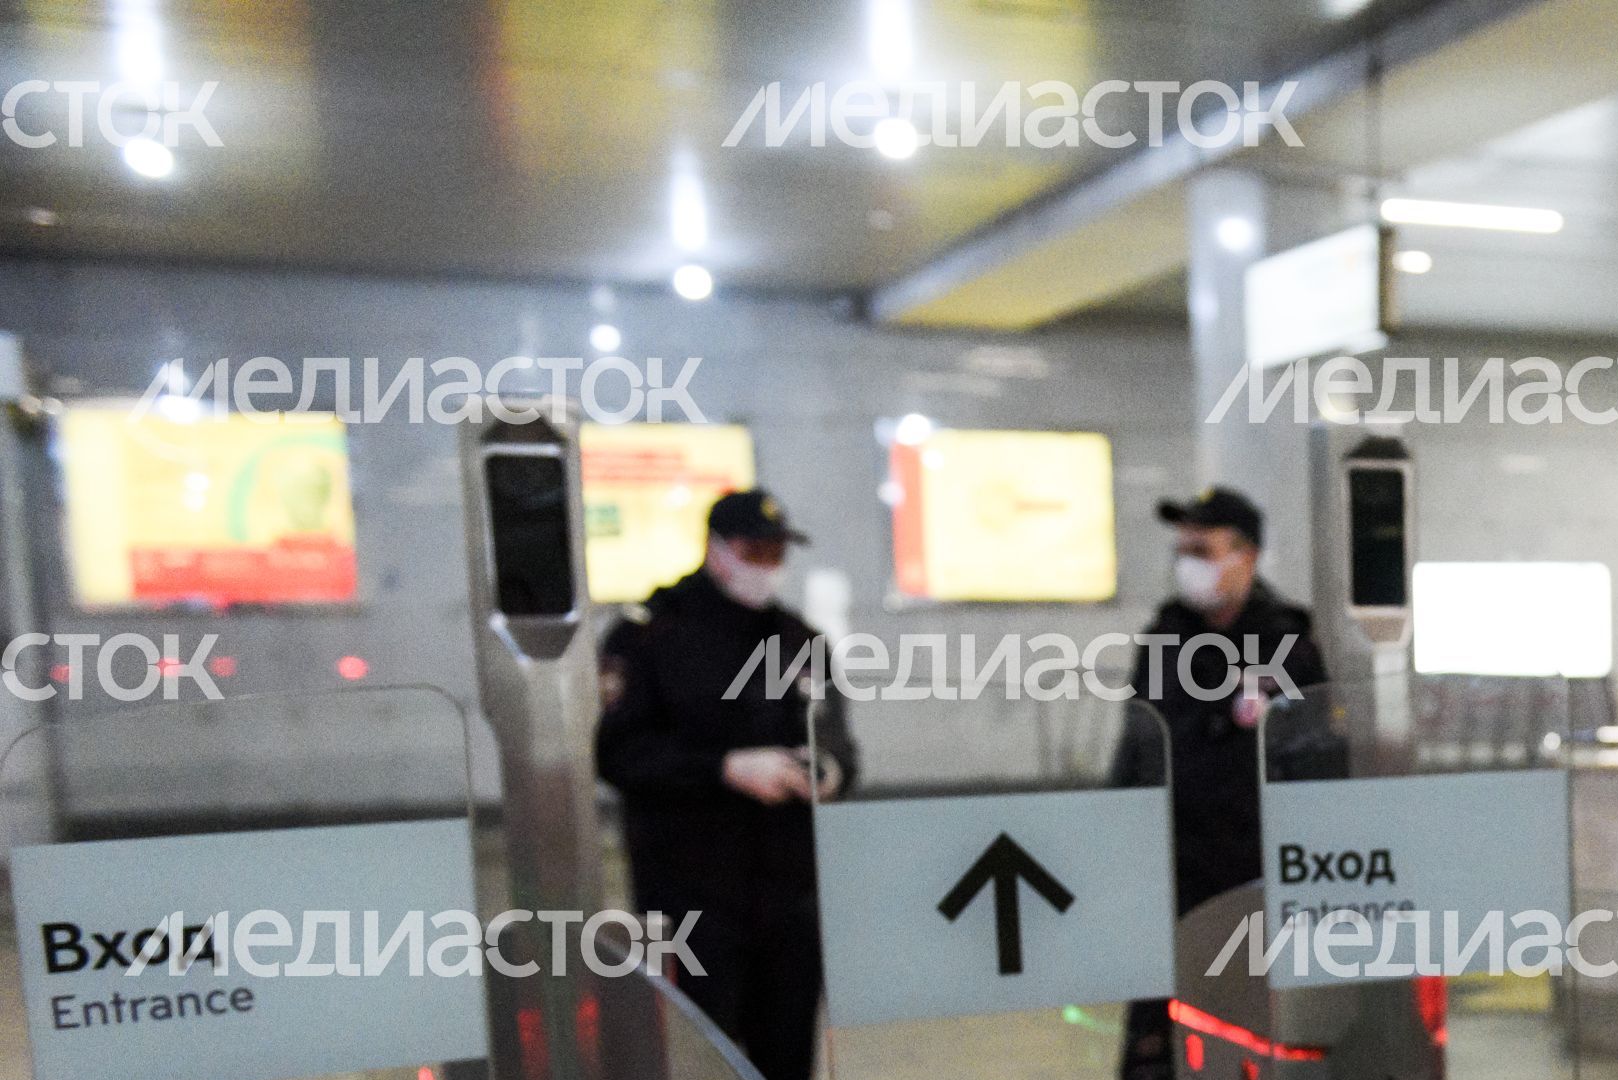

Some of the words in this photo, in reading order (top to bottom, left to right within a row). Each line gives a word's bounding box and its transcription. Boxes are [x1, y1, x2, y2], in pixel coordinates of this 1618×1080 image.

[1279, 844, 1396, 885] Вход
[42, 921, 221, 974] Вход
[52, 985, 254, 1031] Entrance
